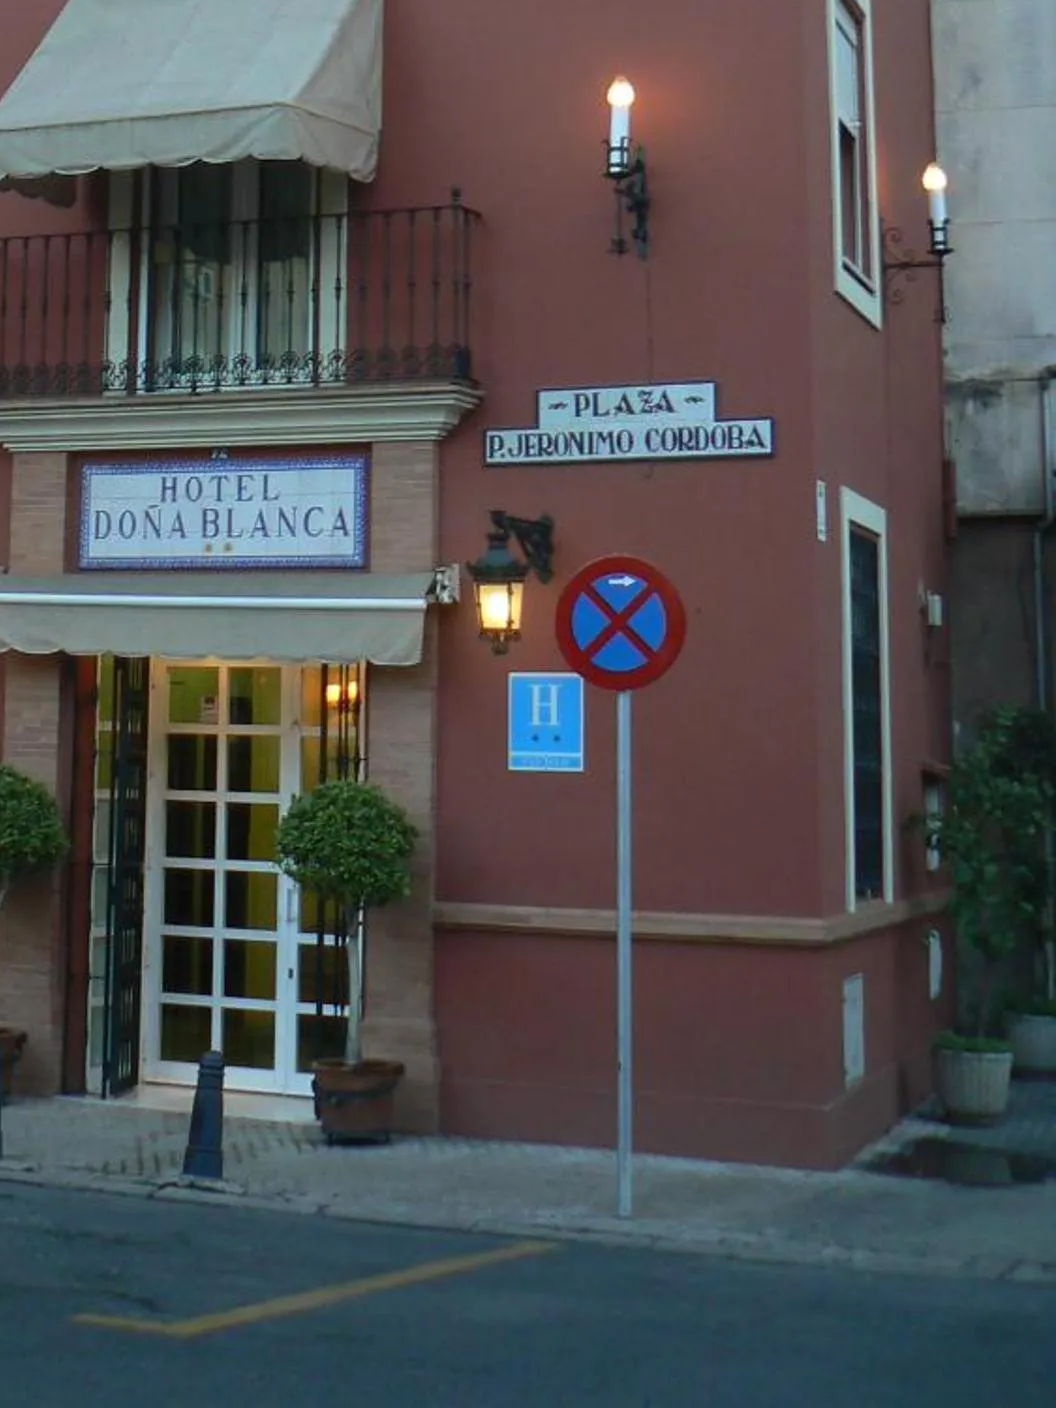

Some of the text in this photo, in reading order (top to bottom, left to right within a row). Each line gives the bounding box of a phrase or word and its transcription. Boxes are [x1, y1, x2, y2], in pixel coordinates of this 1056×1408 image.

[573, 389, 677, 418] PLAZA
[645, 425, 766, 453] CORDOBA
[160, 474, 280, 503] HOTEL
[94, 505, 349, 540] DOÑA BLANCA
[528, 684, 562, 726] H
